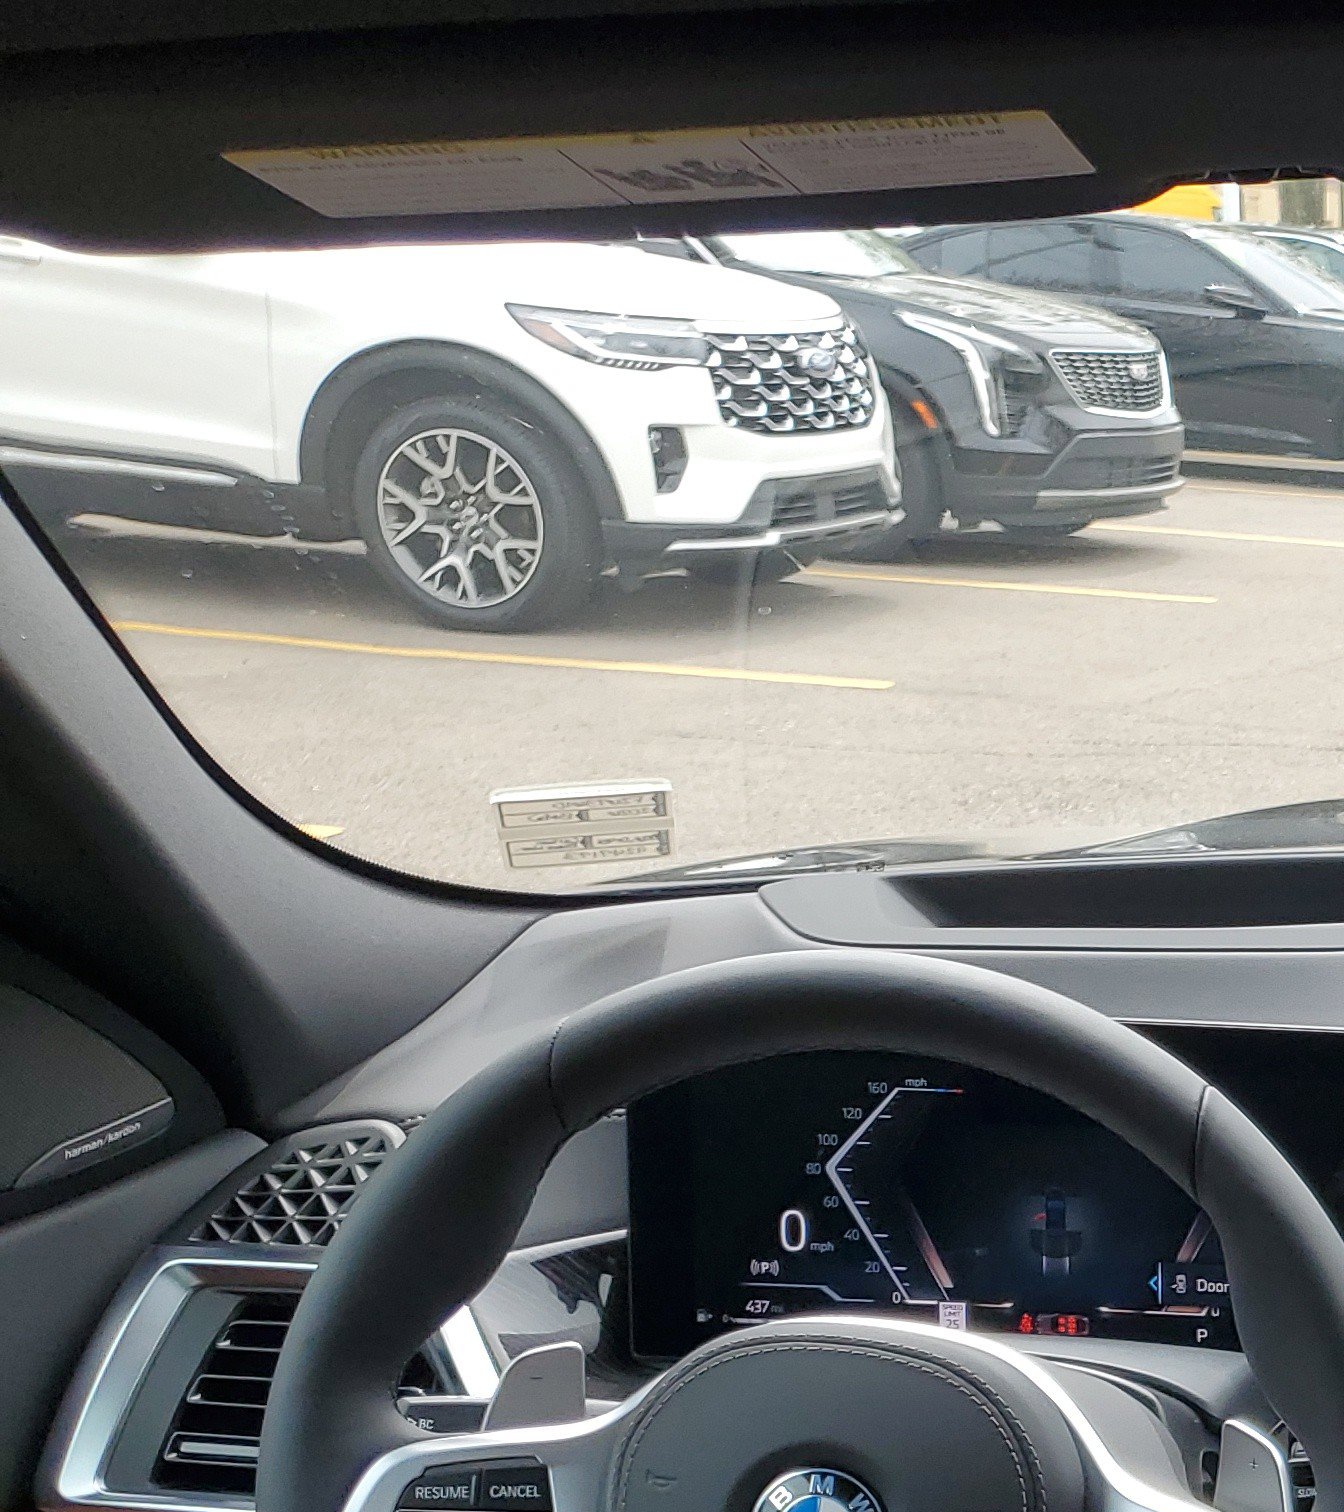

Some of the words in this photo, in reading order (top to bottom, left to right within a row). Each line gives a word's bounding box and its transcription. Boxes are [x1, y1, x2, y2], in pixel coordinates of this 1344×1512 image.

[867, 1082, 888, 1094] 160
[905, 1078, 927, 1087] mph
[842, 1107, 862, 1119] 120
[817, 1133, 838, 1146] 100
[806, 1162, 821, 1175] 80
[823, 1196, 839, 1208] 60
[780, 1209, 807, 1251] 0
[810, 1242, 834, 1252] mph
[843, 1229, 860, 1241] 40
[865, 1261, 880, 1273] 20
[892, 1292, 901, 1304] 0
[745, 1300, 770, 1313] 437
[1196, 1328, 1208, 1342] P
[418, 1418, 434, 1429] BC
[415, 1486, 470, 1499] RESUME
[489, 1485, 541, 1498] CANCEL
